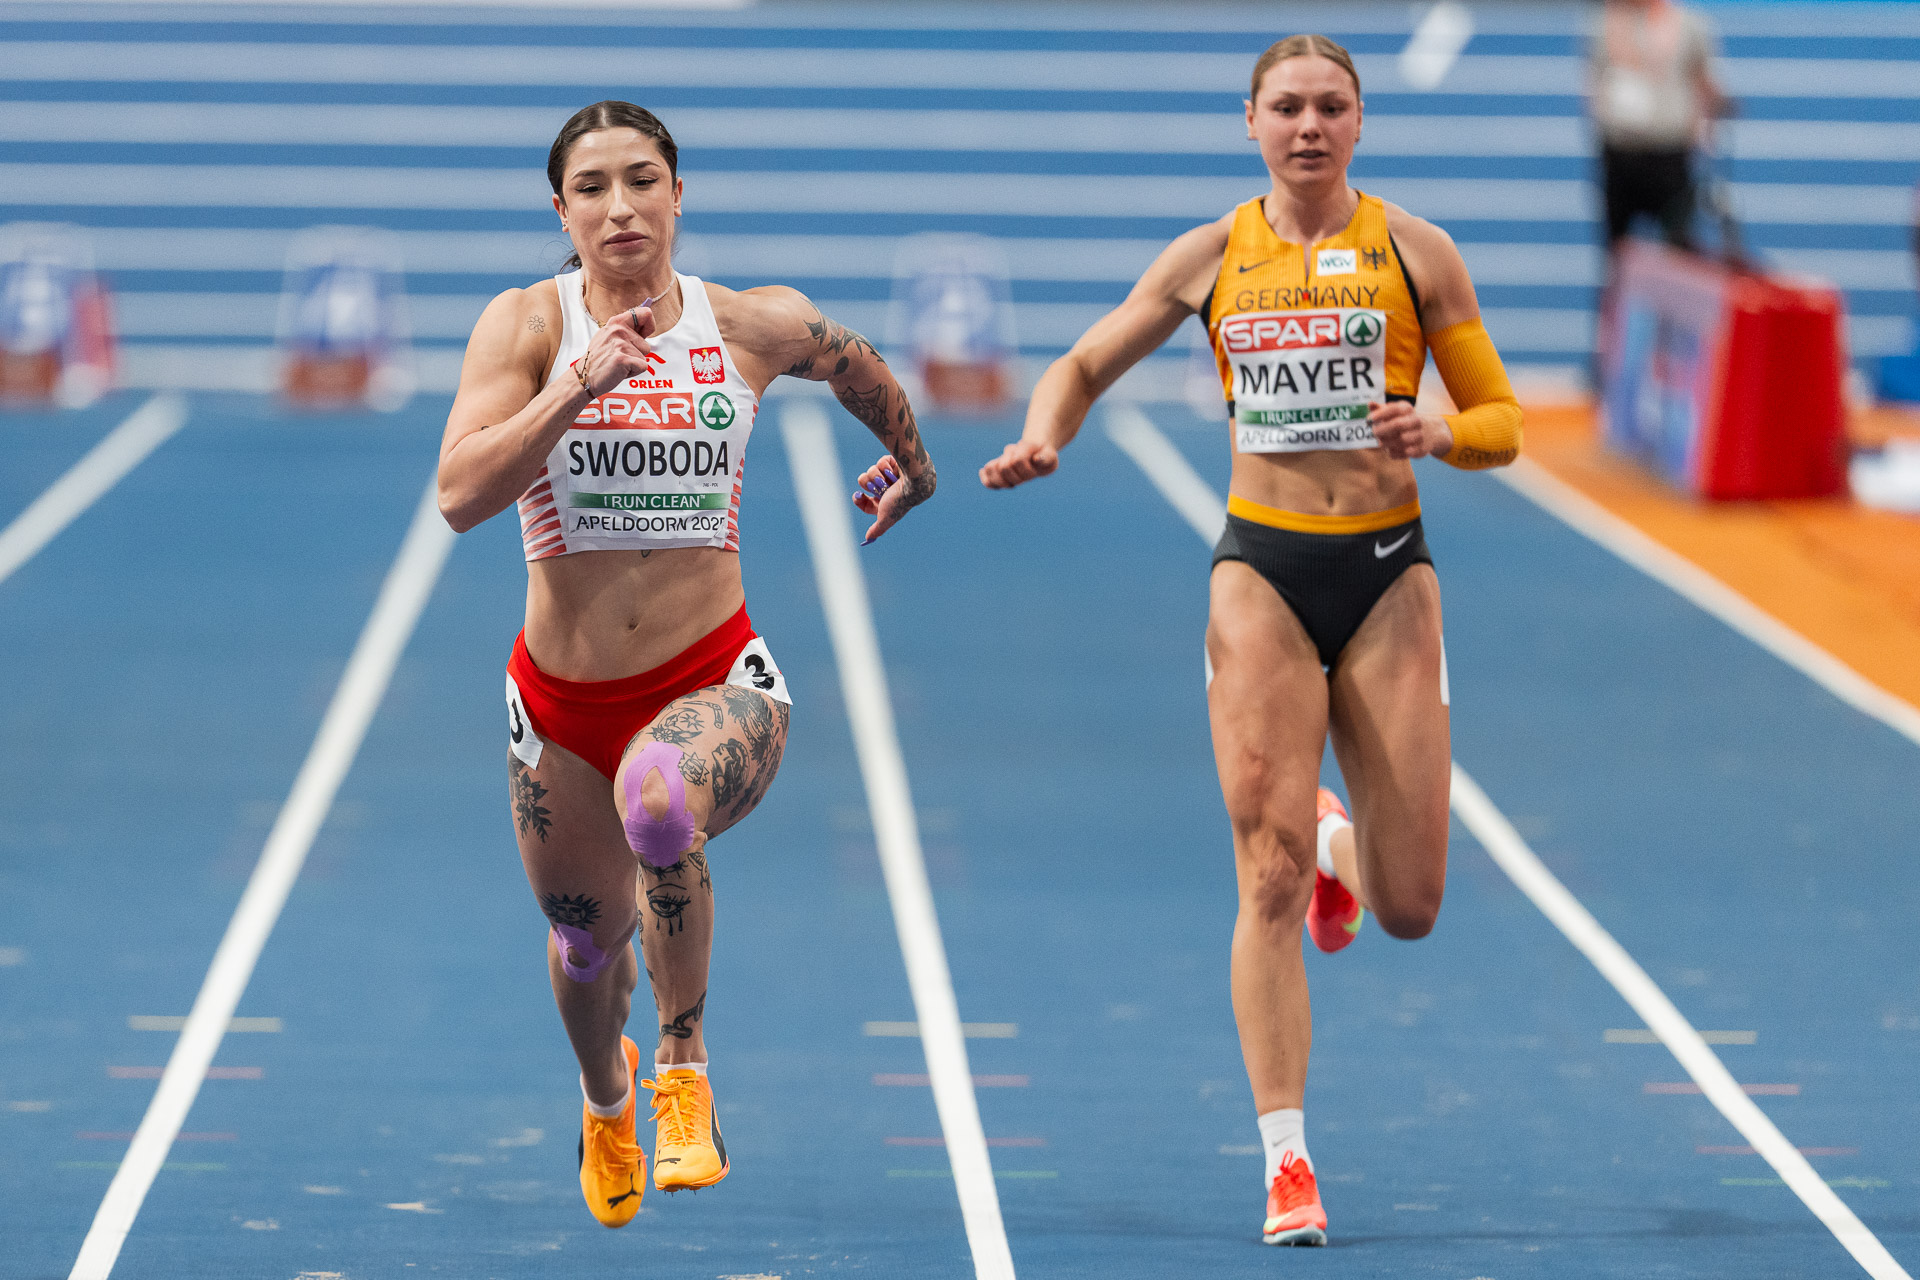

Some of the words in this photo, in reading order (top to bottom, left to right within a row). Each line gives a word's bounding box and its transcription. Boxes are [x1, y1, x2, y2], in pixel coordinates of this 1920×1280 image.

[1319, 256, 1353, 268] WGV
[1236, 286, 1380, 311] GERMANY
[1225, 316, 1339, 350] SPAR
[629, 379, 673, 389] ORLEN
[1239, 357, 1375, 395] MAYER
[574, 397, 693, 425] SPAR
[569, 440, 729, 477] SWOBODA
[612, 496, 647, 508] RUN
[576, 516, 689, 532] APELDOORN
